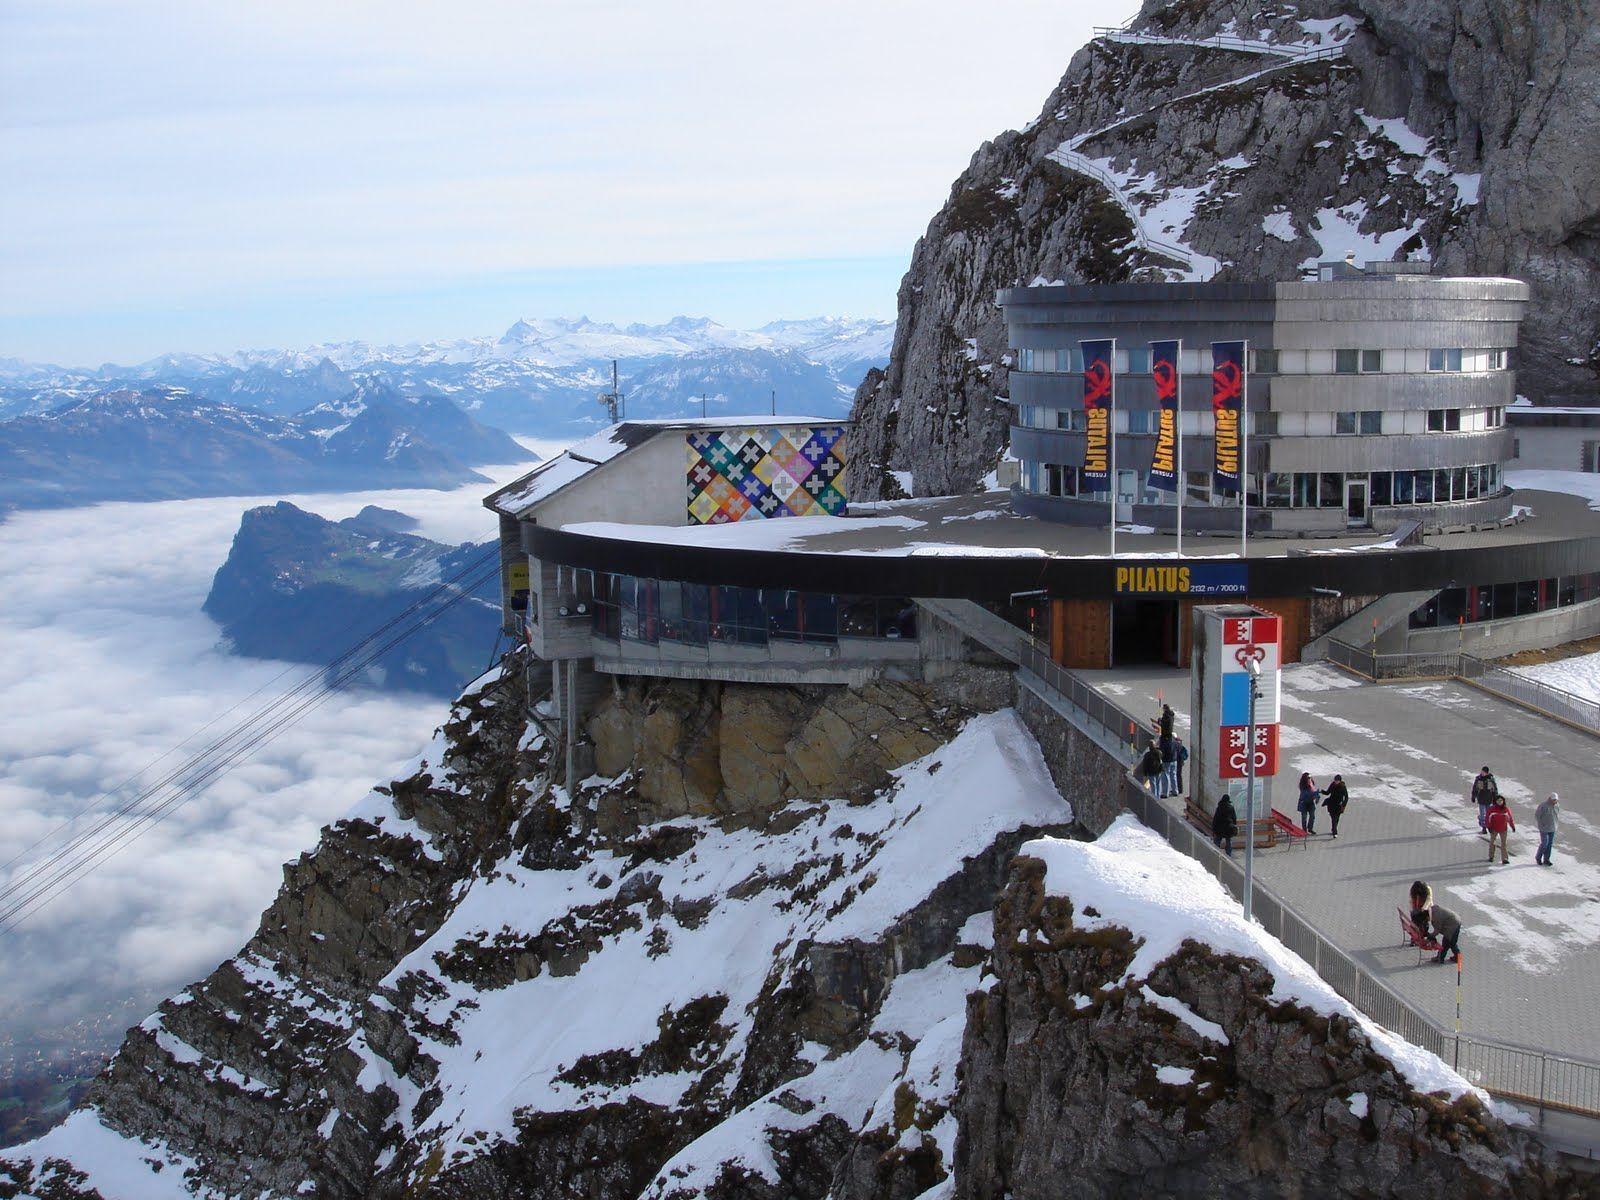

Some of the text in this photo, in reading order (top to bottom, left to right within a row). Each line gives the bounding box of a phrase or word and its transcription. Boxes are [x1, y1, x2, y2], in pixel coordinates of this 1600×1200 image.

[1116, 567, 1190, 592] PILATUS
[1220, 584, 1238, 592] 7000
[1240, 584, 1245, 592] ft
